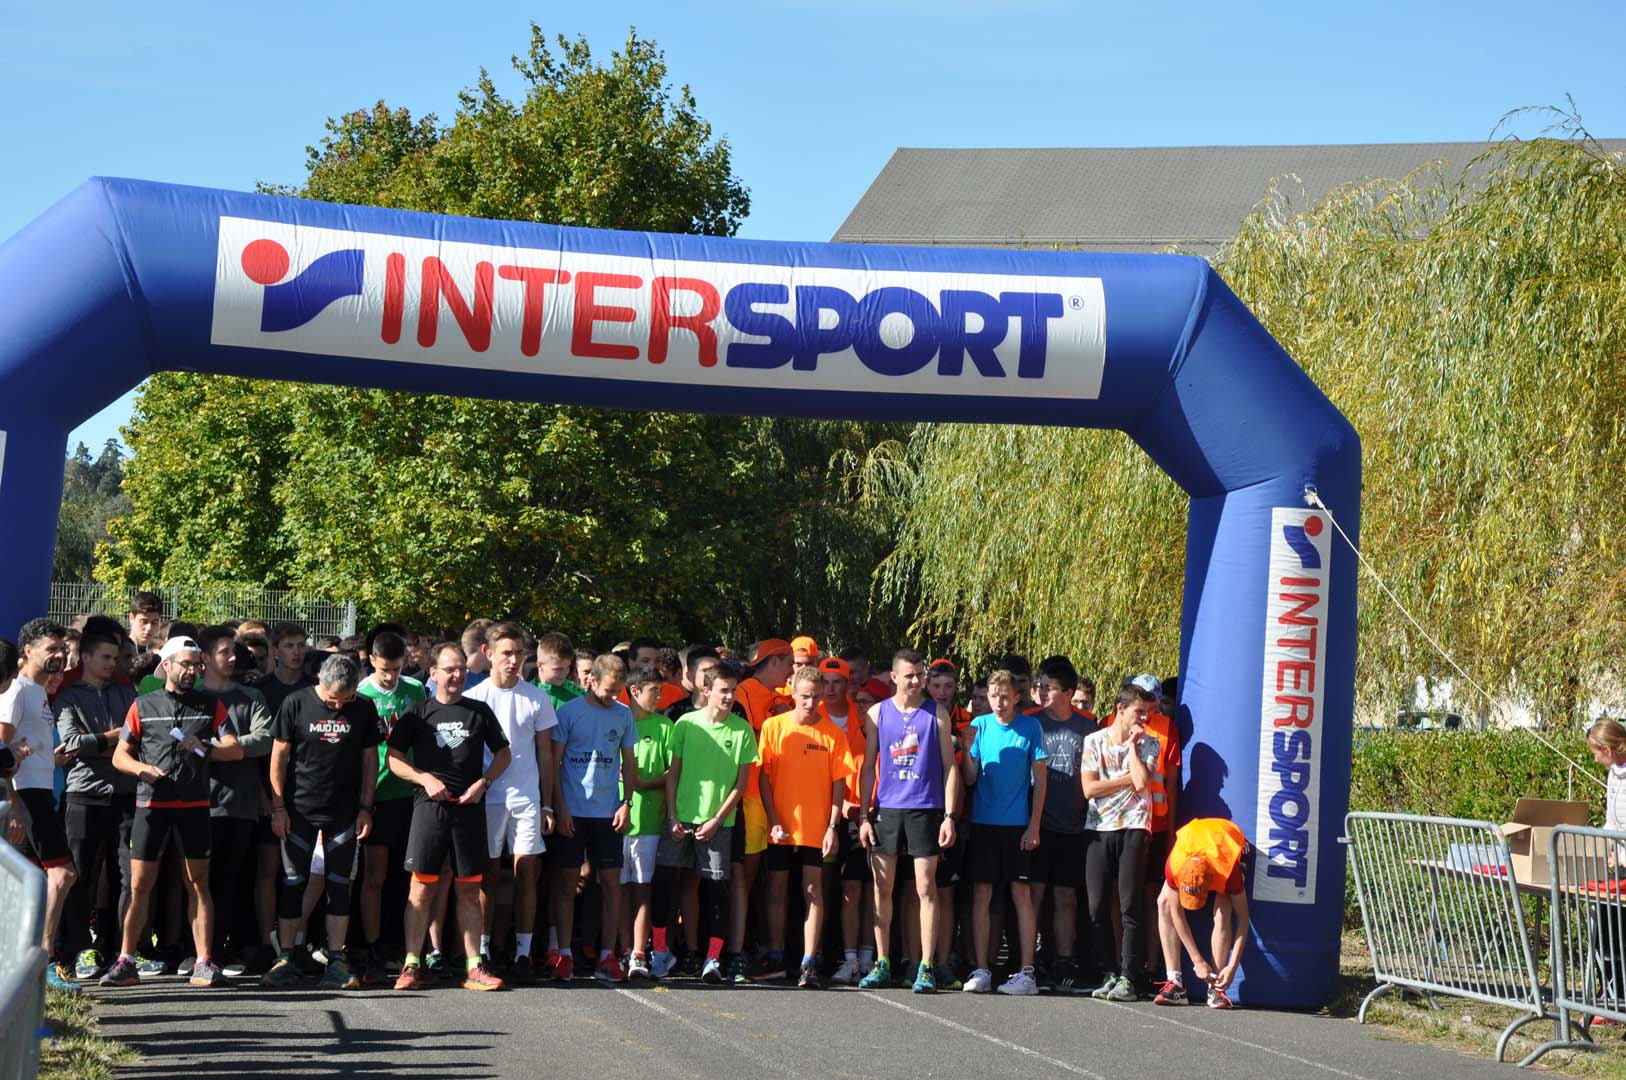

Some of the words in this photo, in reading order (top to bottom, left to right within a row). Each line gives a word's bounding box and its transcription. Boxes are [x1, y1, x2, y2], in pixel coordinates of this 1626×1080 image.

[381, 252, 1064, 379] INTERSPORT
[309, 722, 331, 733] MUD
[332, 723, 351, 733] DAY
[1266, 576, 1320, 888] INTERSPORT
